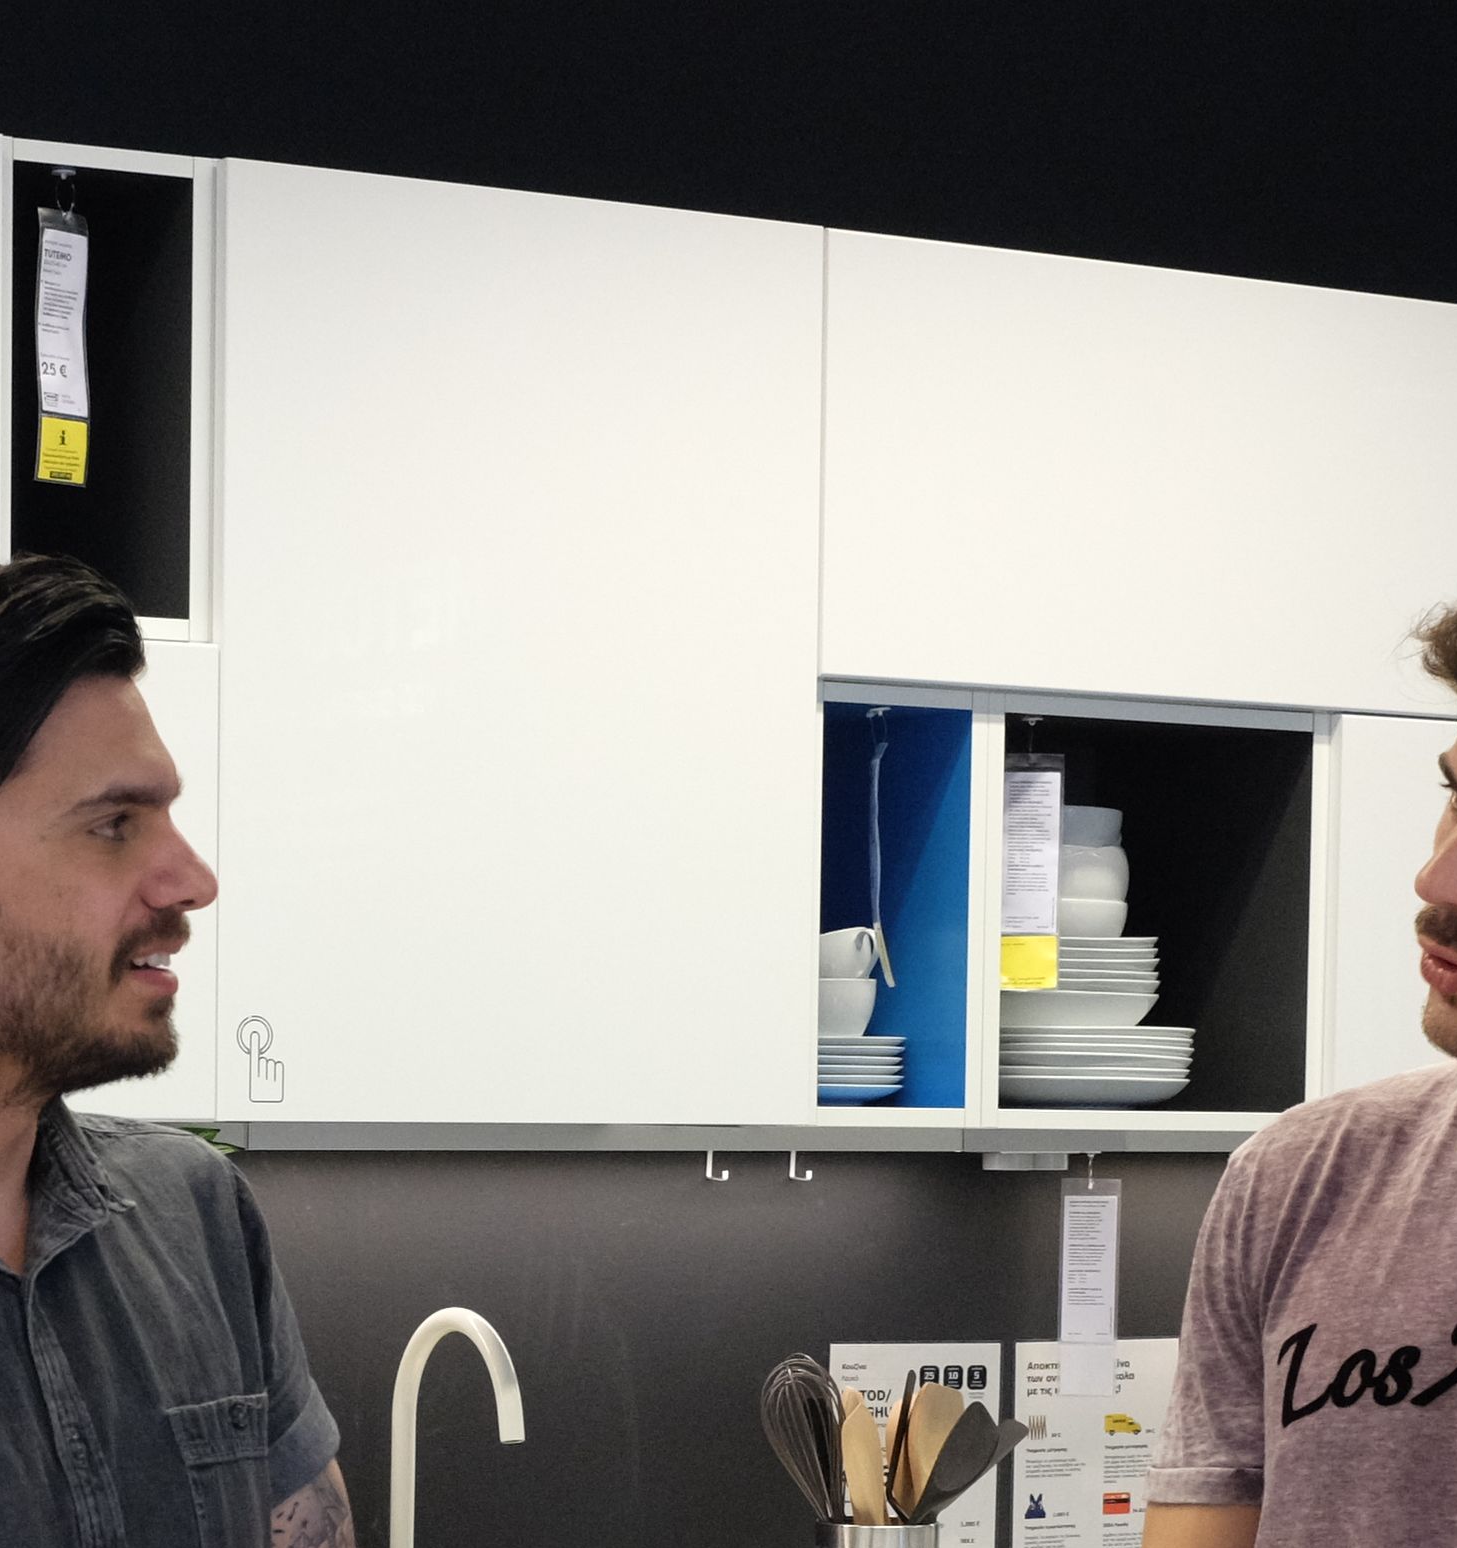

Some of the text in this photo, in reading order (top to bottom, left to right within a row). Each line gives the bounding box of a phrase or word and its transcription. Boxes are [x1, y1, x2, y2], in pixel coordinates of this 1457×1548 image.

[41, 361, 57, 376] 25
[923, 1371, 935, 1380] 25
[948, 1371, 959, 1380] 10
[1277, 1323, 1421, 1428] Los
